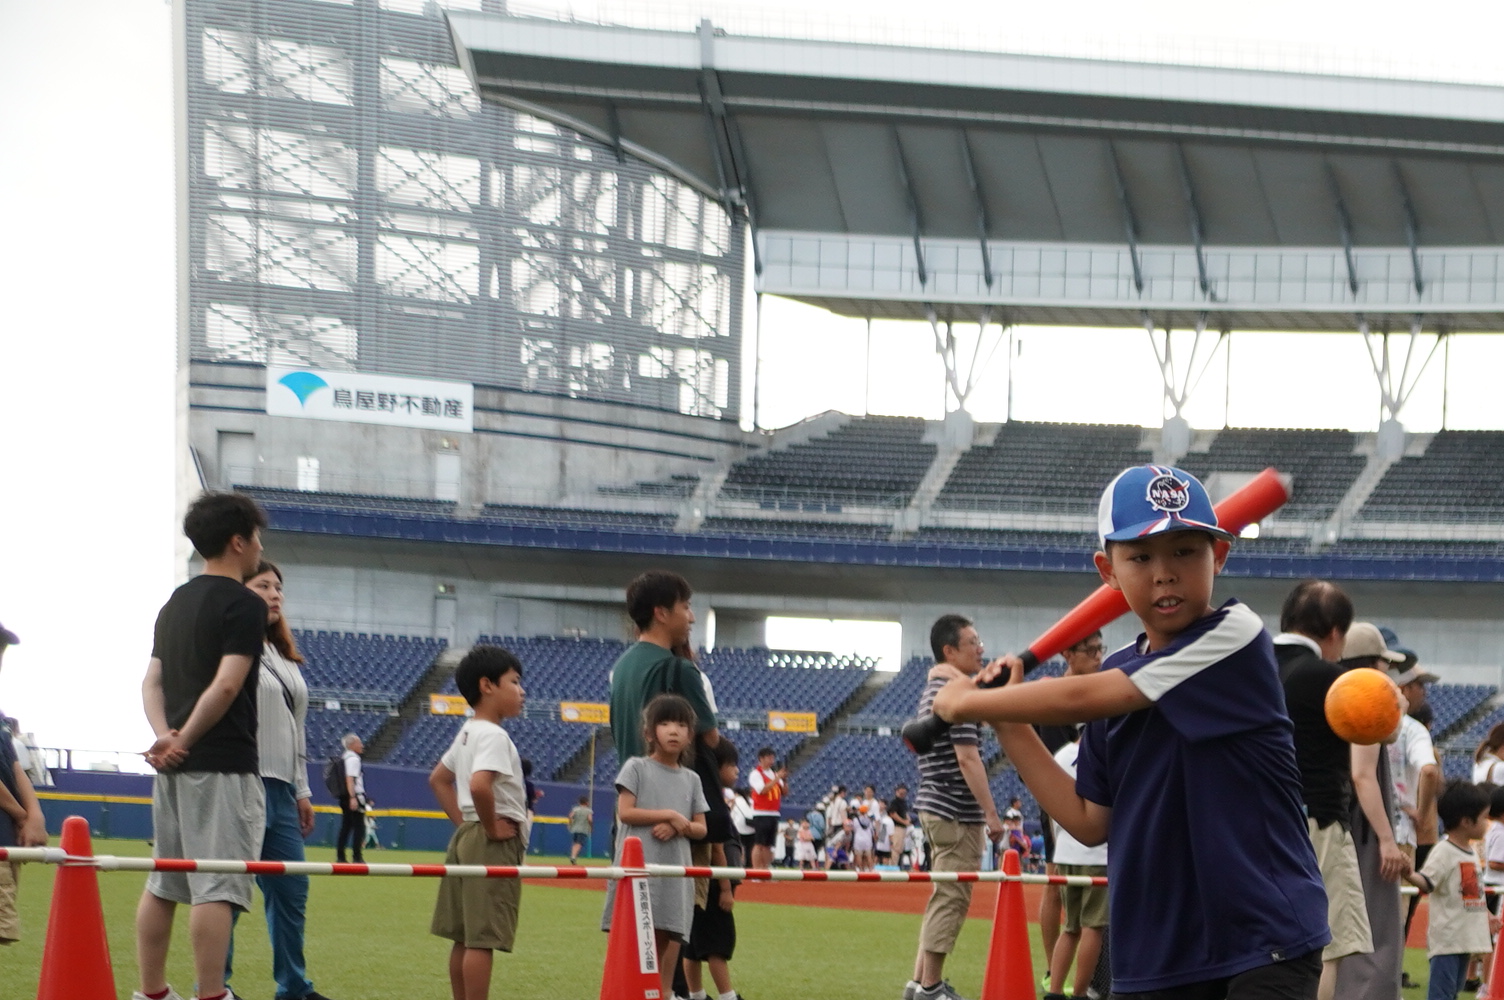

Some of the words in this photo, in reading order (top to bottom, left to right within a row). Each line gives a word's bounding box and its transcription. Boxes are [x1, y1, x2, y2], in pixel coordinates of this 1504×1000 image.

[333, 388, 464, 419] 鳥屋野不動産
[1152, 489, 1186, 499] NASA
